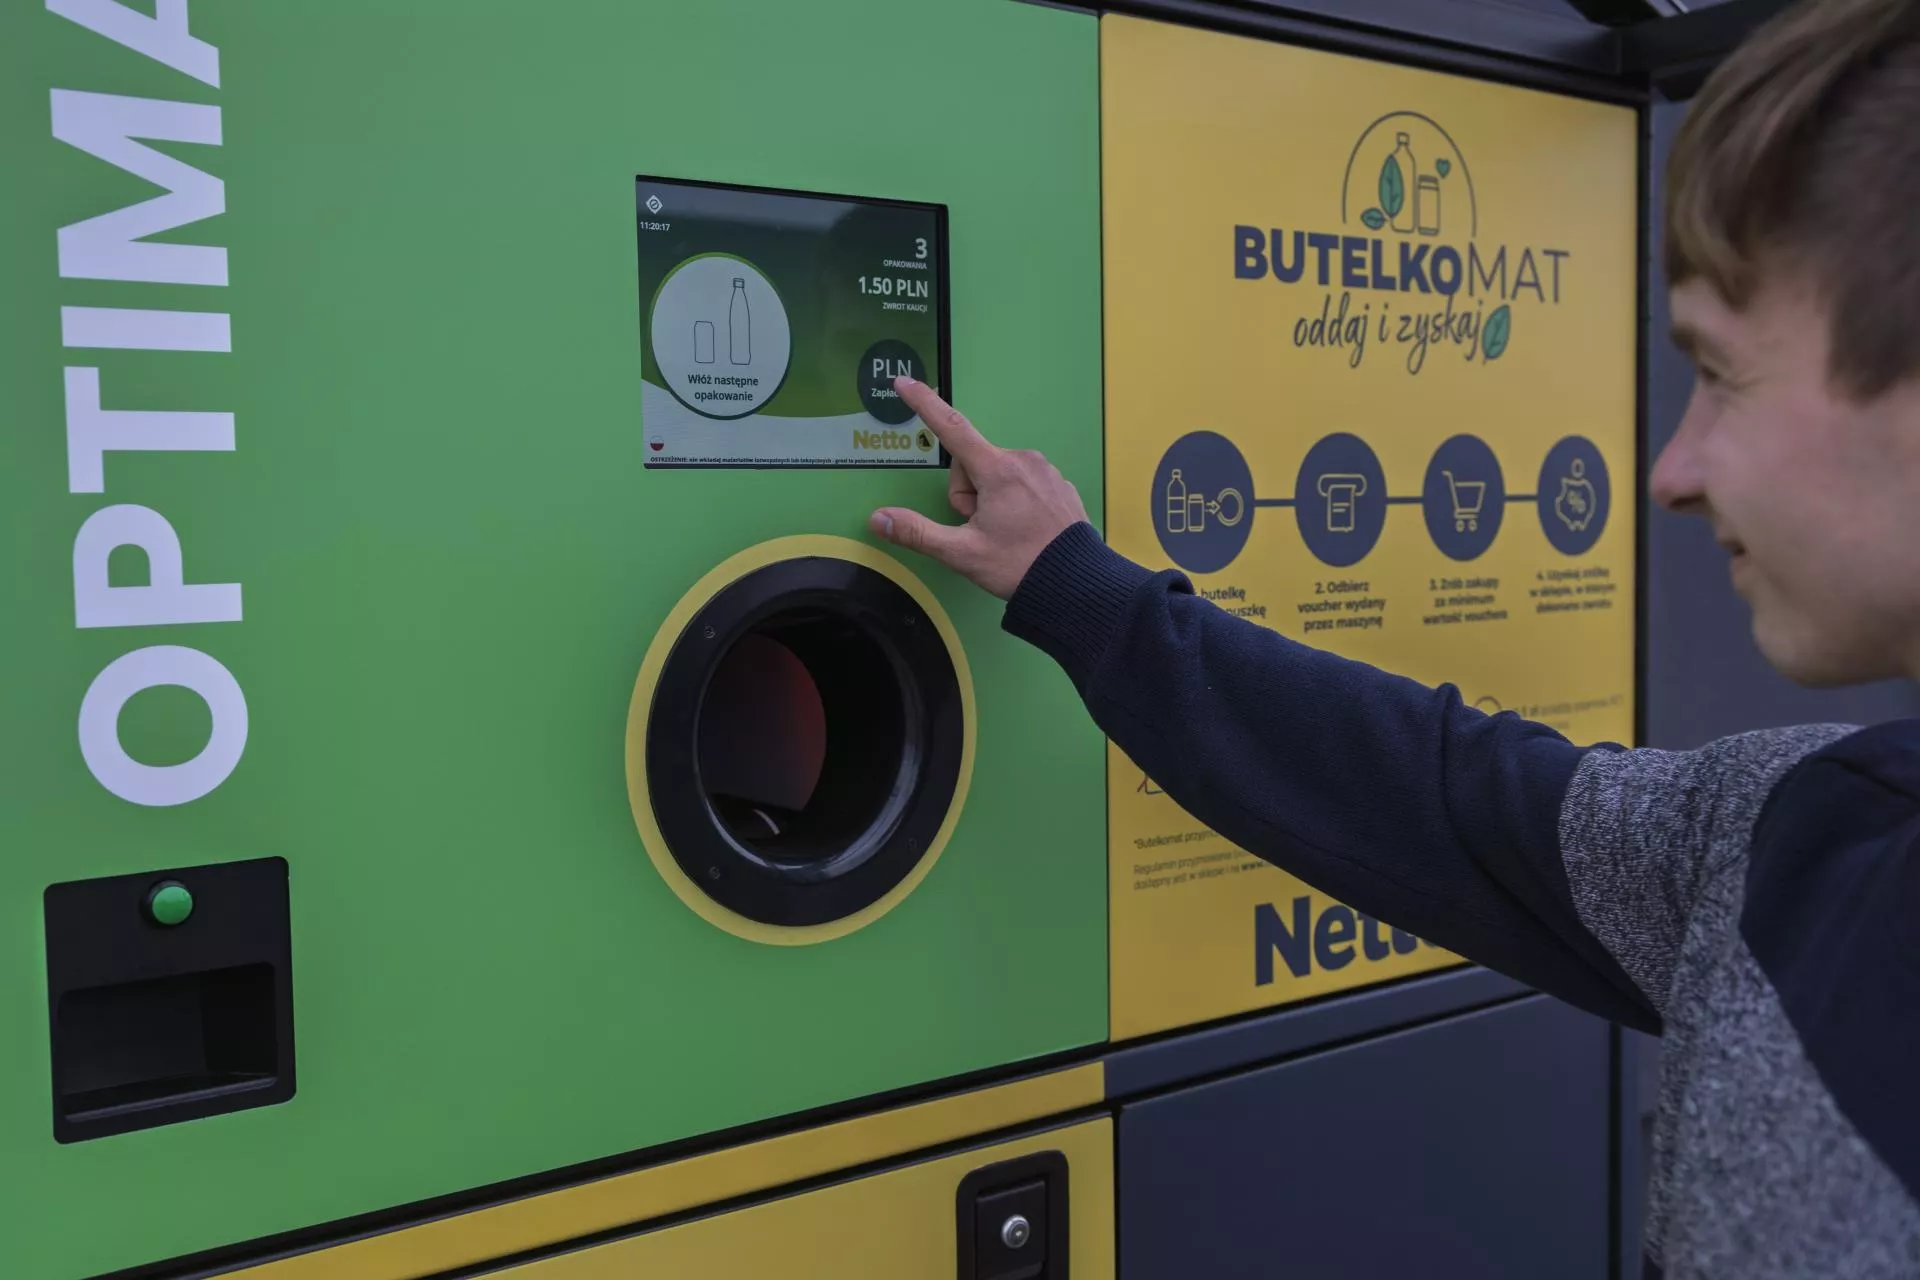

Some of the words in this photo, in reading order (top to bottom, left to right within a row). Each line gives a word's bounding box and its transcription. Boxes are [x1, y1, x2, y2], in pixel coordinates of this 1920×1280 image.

[640, 220, 671, 232] 11:20:17
[915, 237, 928, 259] 3
[883, 259, 928, 270] OPAKOWANIA
[1233, 223, 1570, 304] BUTELKOMAT
[858, 276, 893, 295] 1.50
[896, 279, 928, 298] PLN
[882, 302, 905, 311] ZWROT
[1293, 291, 1370, 369] oddaj
[1378, 302, 1390, 343] i
[1396, 294, 1485, 376] zyskaj
[872, 358, 912, 378] PLN
[687, 373, 712, 385] Włóż
[714, 375, 759, 388] następne
[694, 390, 753, 402] opakowanie
[852, 429, 912, 450] Netto
[1200, 585, 1246, 602] butelkę
[1314, 582, 1325, 595] 2.
[1327, 580, 1370, 594] Odbierz
[1297, 600, 1342, 614] voucher
[1345, 597, 1386, 612] wydany
[1304, 618, 1334, 634] przez
[1336, 615, 1384, 631] maszynę
[1254, 895, 1437, 987] Net
